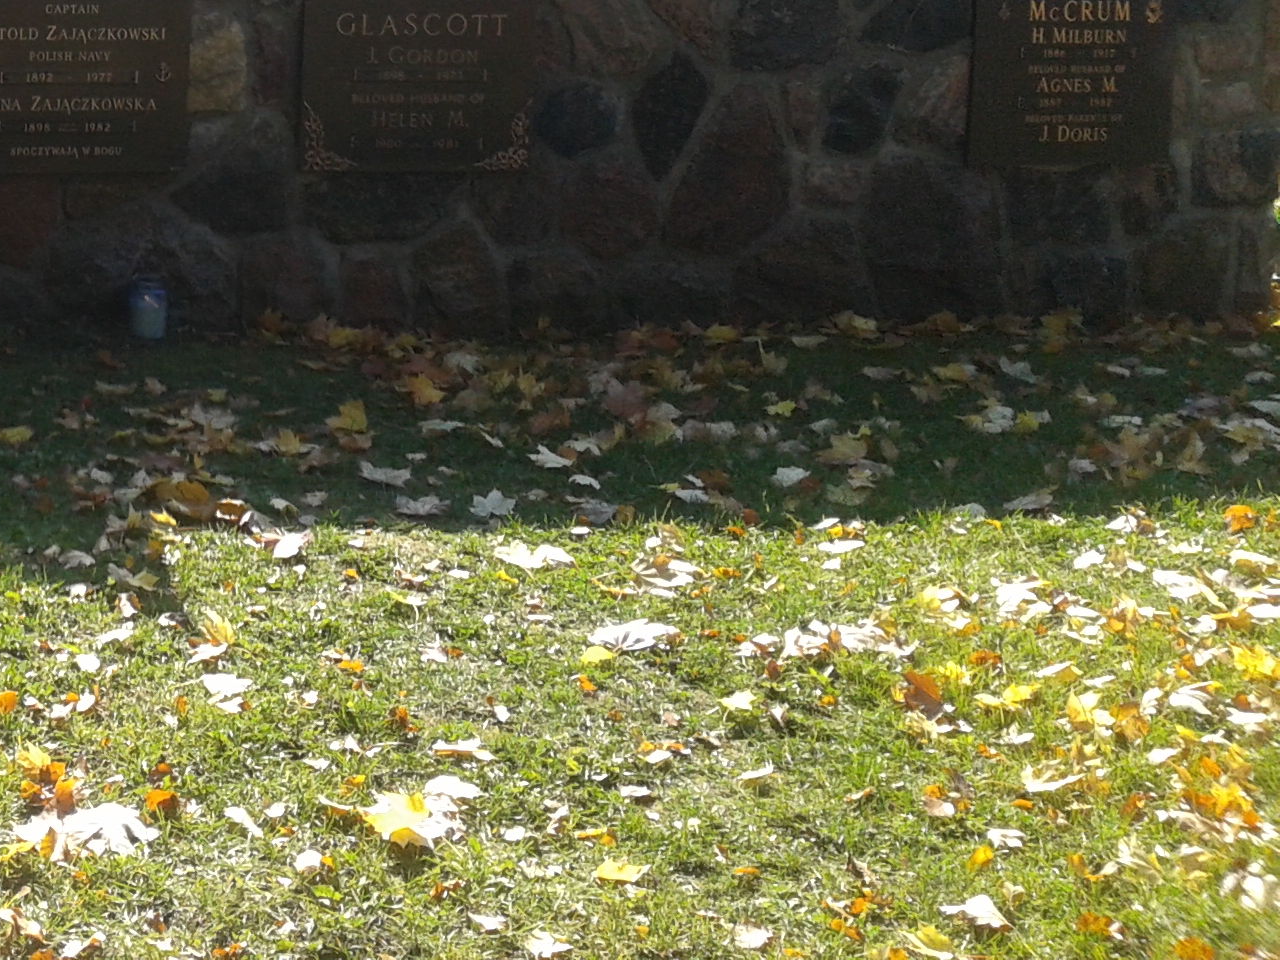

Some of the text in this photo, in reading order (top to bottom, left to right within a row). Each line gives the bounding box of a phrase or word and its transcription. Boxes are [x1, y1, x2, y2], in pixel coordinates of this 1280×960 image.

[45, 4, 99, 15] CAPTAIN
[336, 12, 509, 37] GLASCOTT
[46, 25, 166, 45] ZAJĄCZKOWSKI
[1053, 27, 1128, 45] MILBURN
[29, 51, 112, 62] POLISH NAVY
[387, 46, 479, 64] GORDON
[26, 72, 54, 83] 1892
[1036, 77, 1092, 93] AGNES
[30, 95, 158, 115] ZAJĄCZKOWSKA
[371, 110, 434, 128] HELEN
[1057, 125, 1109, 142] DORIS
[81, 146, 91, 156] W
[94, 146, 122, 156] BOGU
